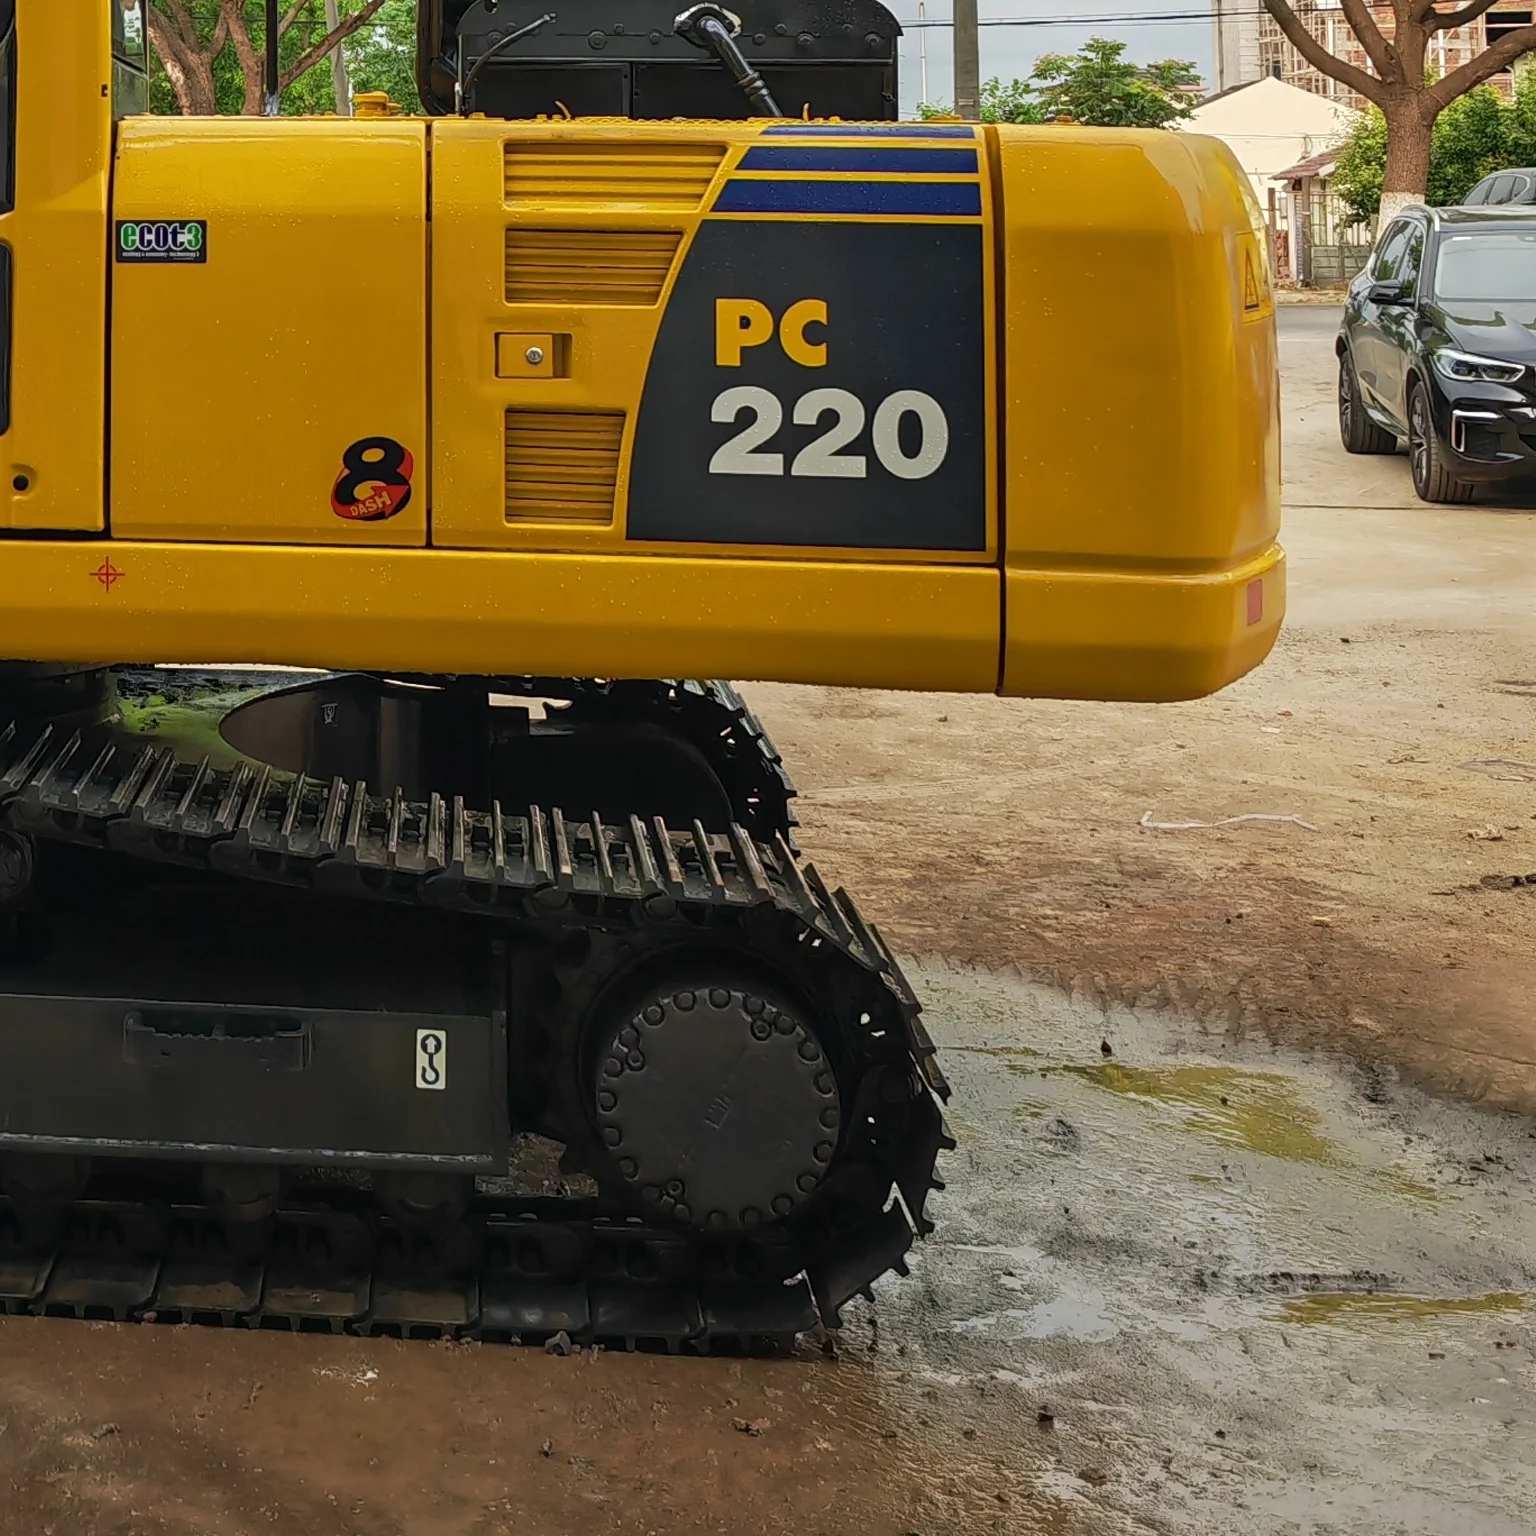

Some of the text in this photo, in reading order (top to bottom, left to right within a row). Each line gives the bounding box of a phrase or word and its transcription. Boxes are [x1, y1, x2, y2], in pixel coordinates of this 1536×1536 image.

[715, 297, 828, 368] PC
[708, 385, 950, 480] 220
[335, 436, 412, 521] 8
[349, 490, 392, 517] DASH
